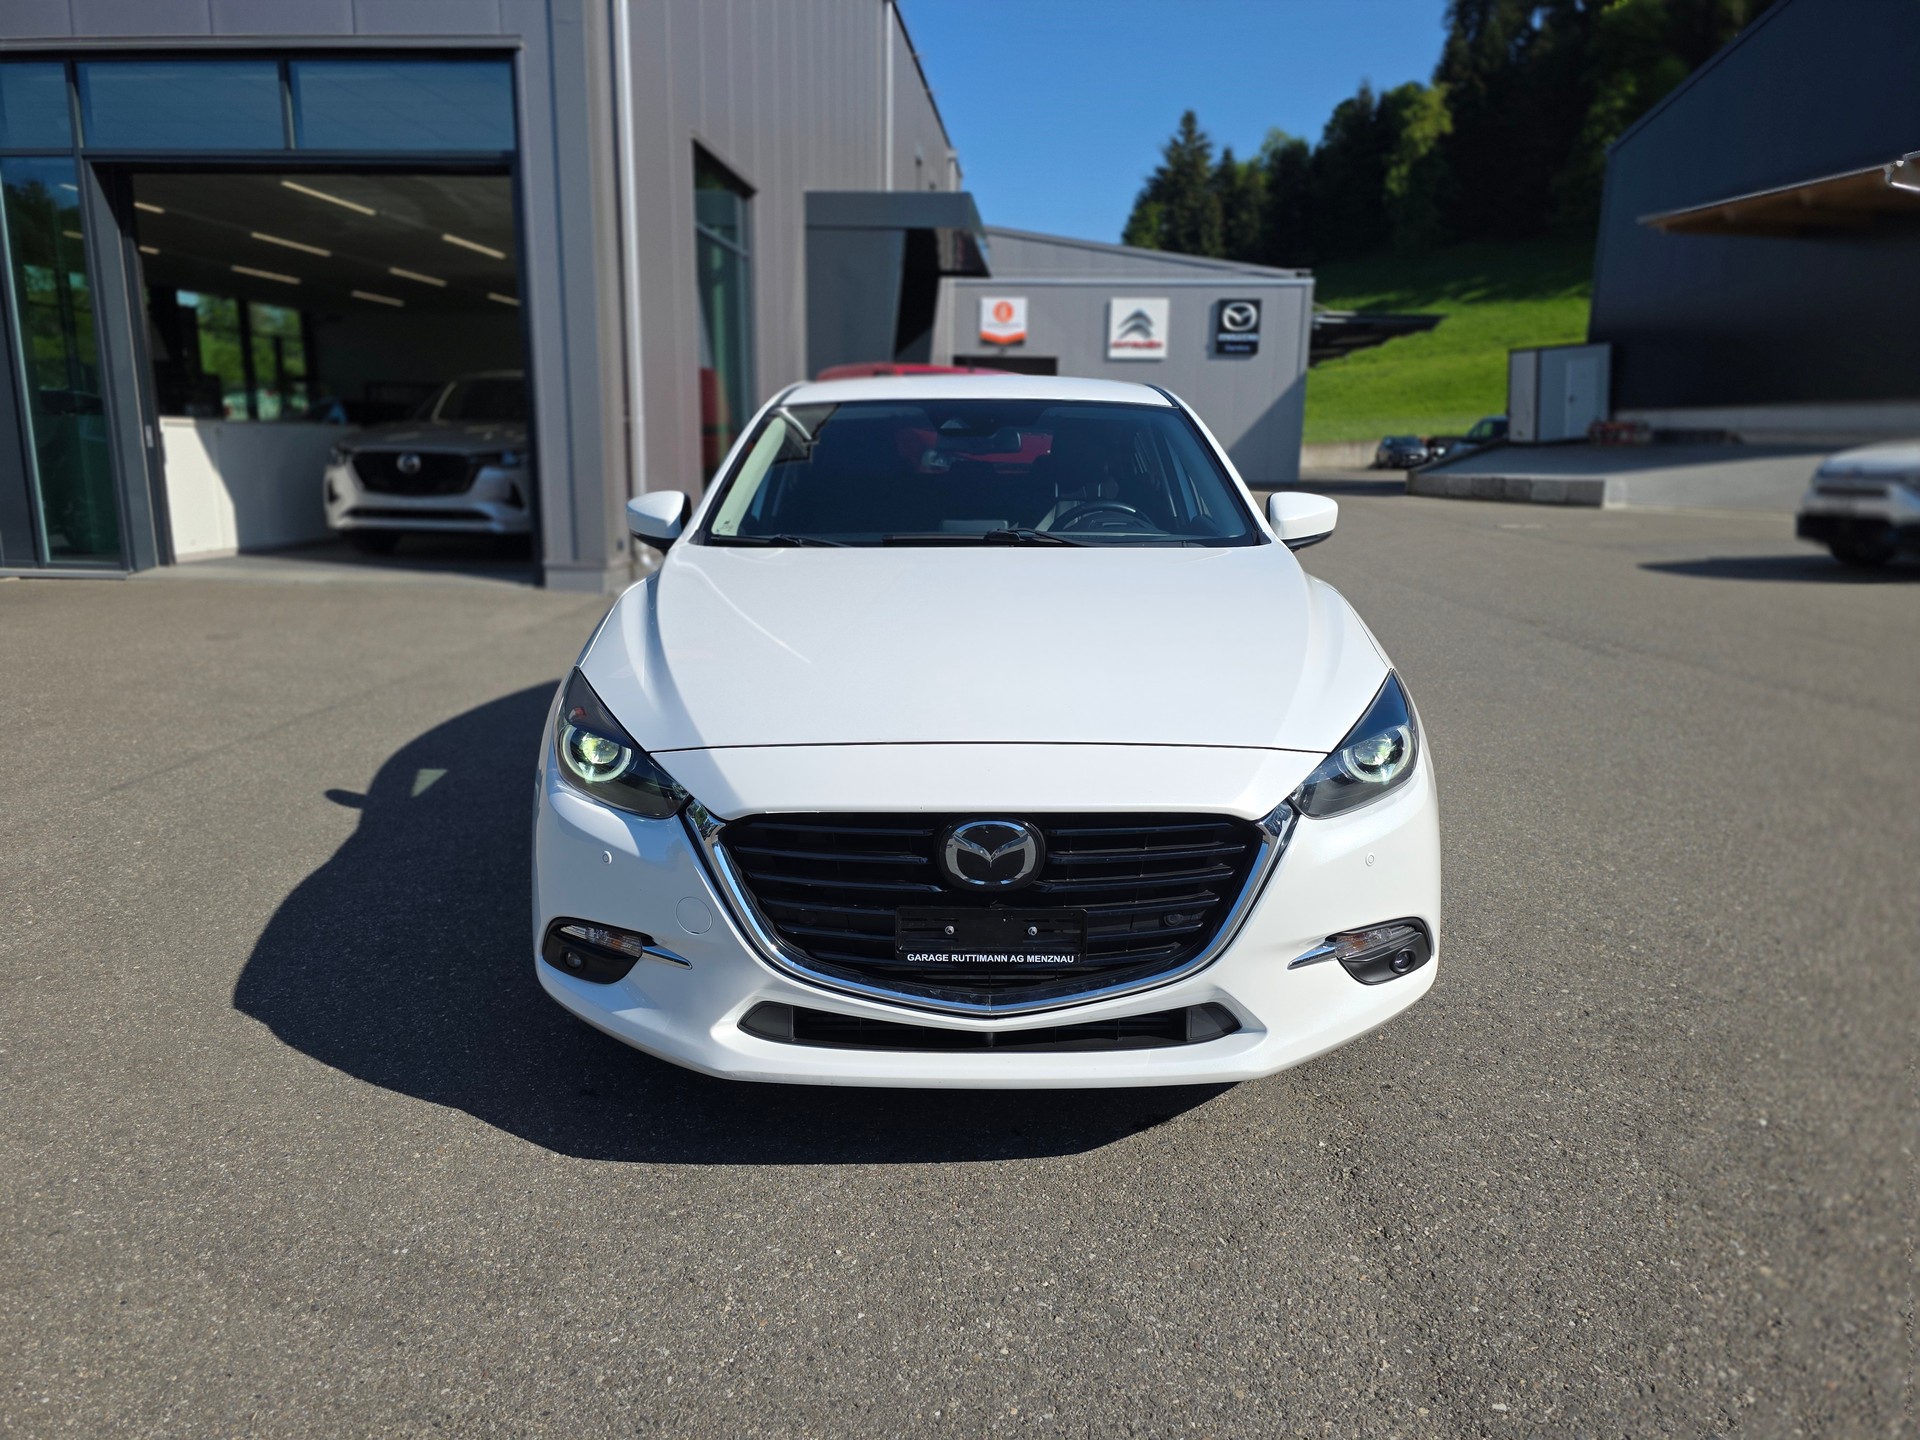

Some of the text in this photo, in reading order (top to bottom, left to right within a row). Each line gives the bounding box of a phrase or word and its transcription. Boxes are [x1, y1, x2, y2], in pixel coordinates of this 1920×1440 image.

[906, 953, 1075, 963] GARAGE RUTTIMANN AG MENZNAU
